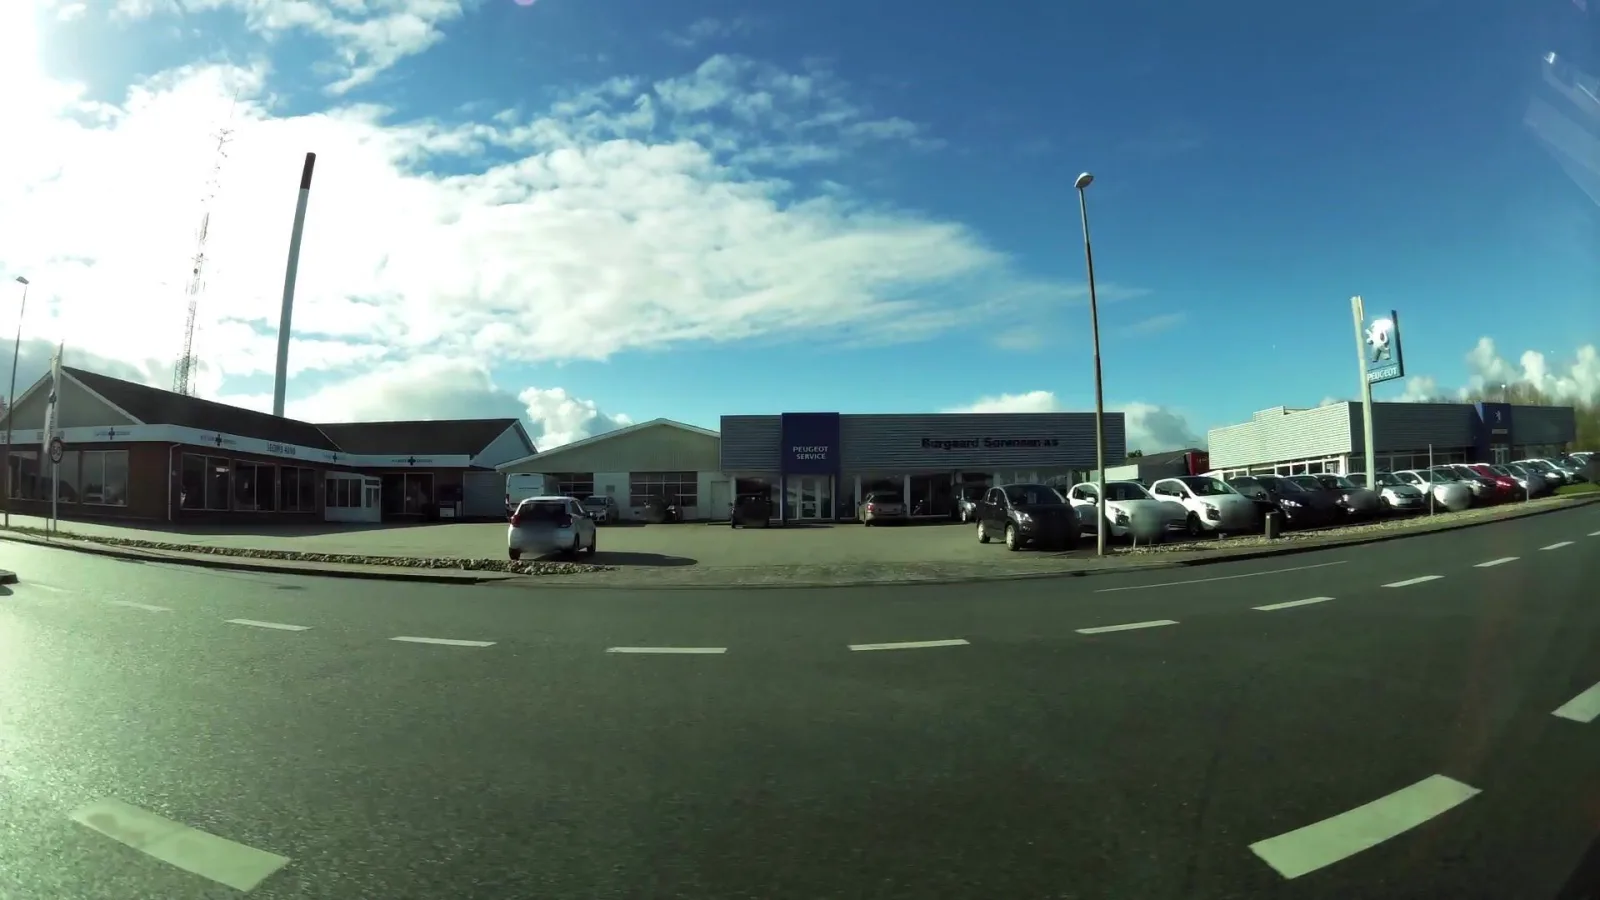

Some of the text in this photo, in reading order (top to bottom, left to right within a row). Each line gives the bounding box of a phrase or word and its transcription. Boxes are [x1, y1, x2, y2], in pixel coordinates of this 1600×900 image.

[1366, 367, 1398, 381] PEUGEOT
[792, 445, 829, 453] PEUGEOT
[796, 452, 826, 460] SERVICE
